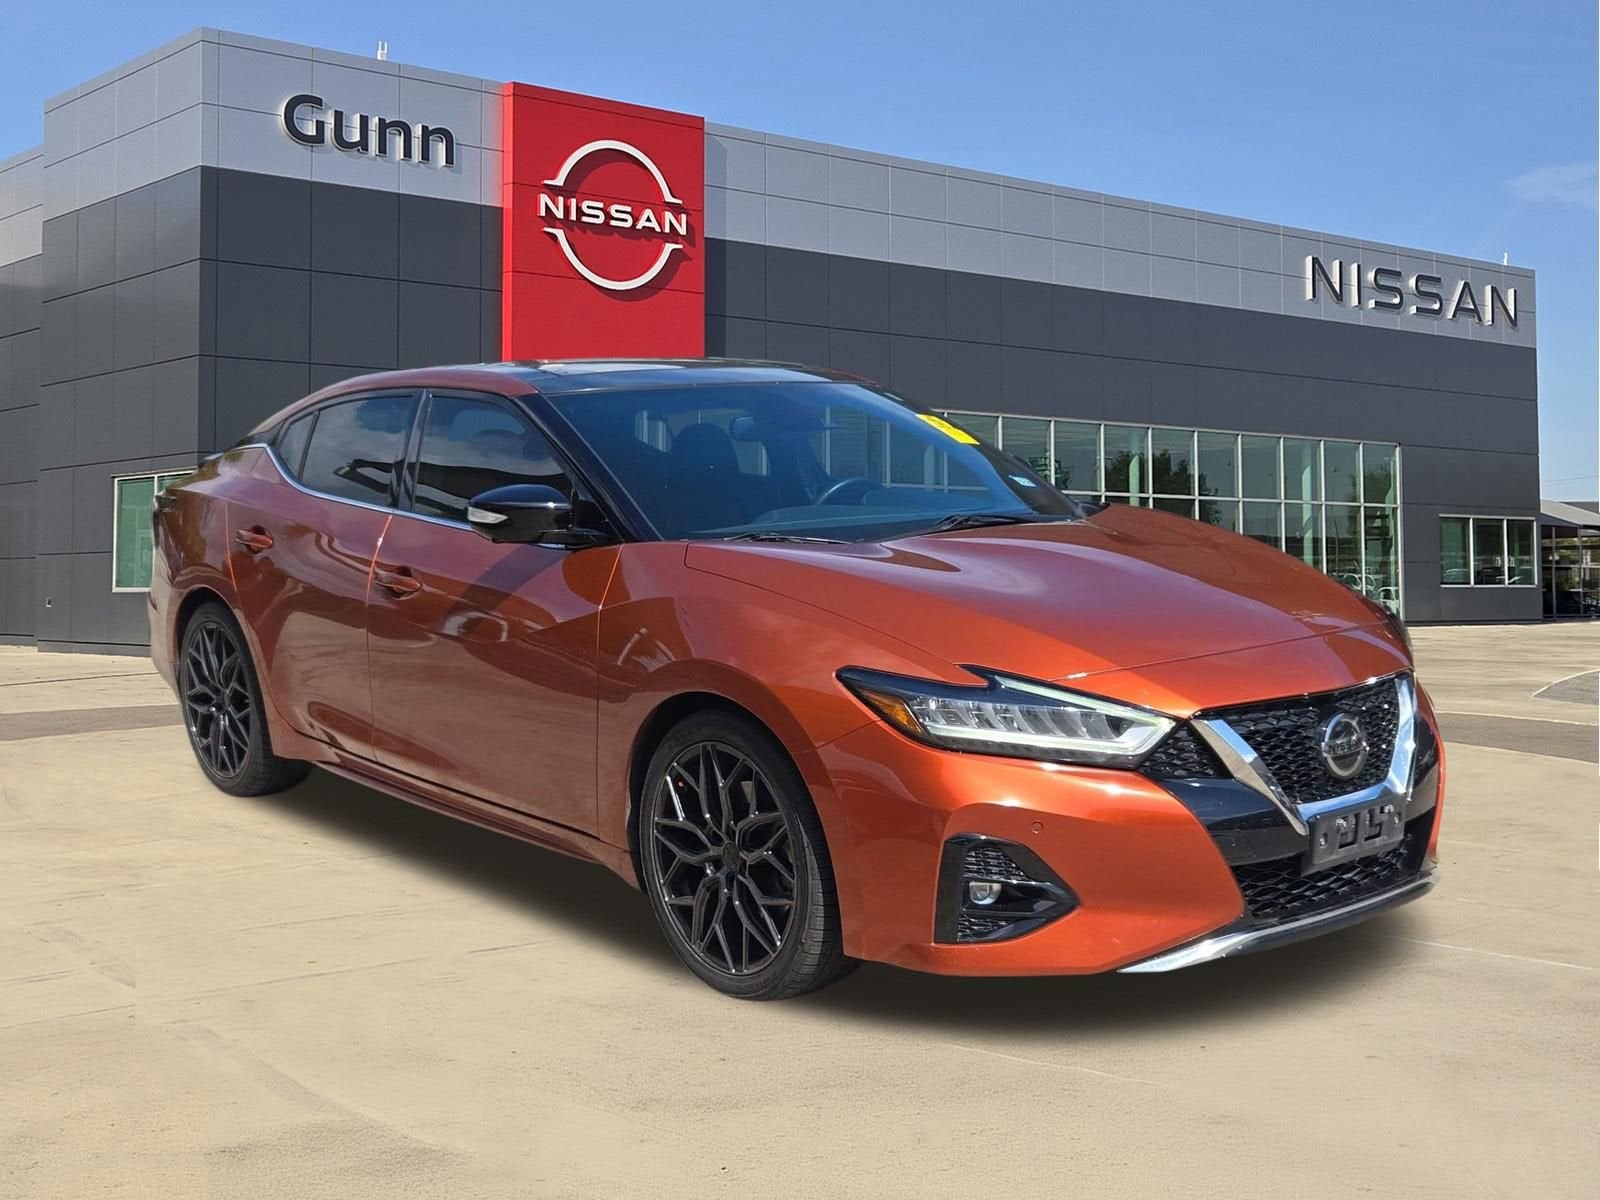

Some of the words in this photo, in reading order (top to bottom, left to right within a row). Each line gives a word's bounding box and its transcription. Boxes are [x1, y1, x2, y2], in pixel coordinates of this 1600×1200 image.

[282, 93, 455, 167] Gunn
[538, 193, 687, 236] NISSAN
[1305, 255, 1518, 328] NISSAN
[1326, 738, 1363, 755] NISS
